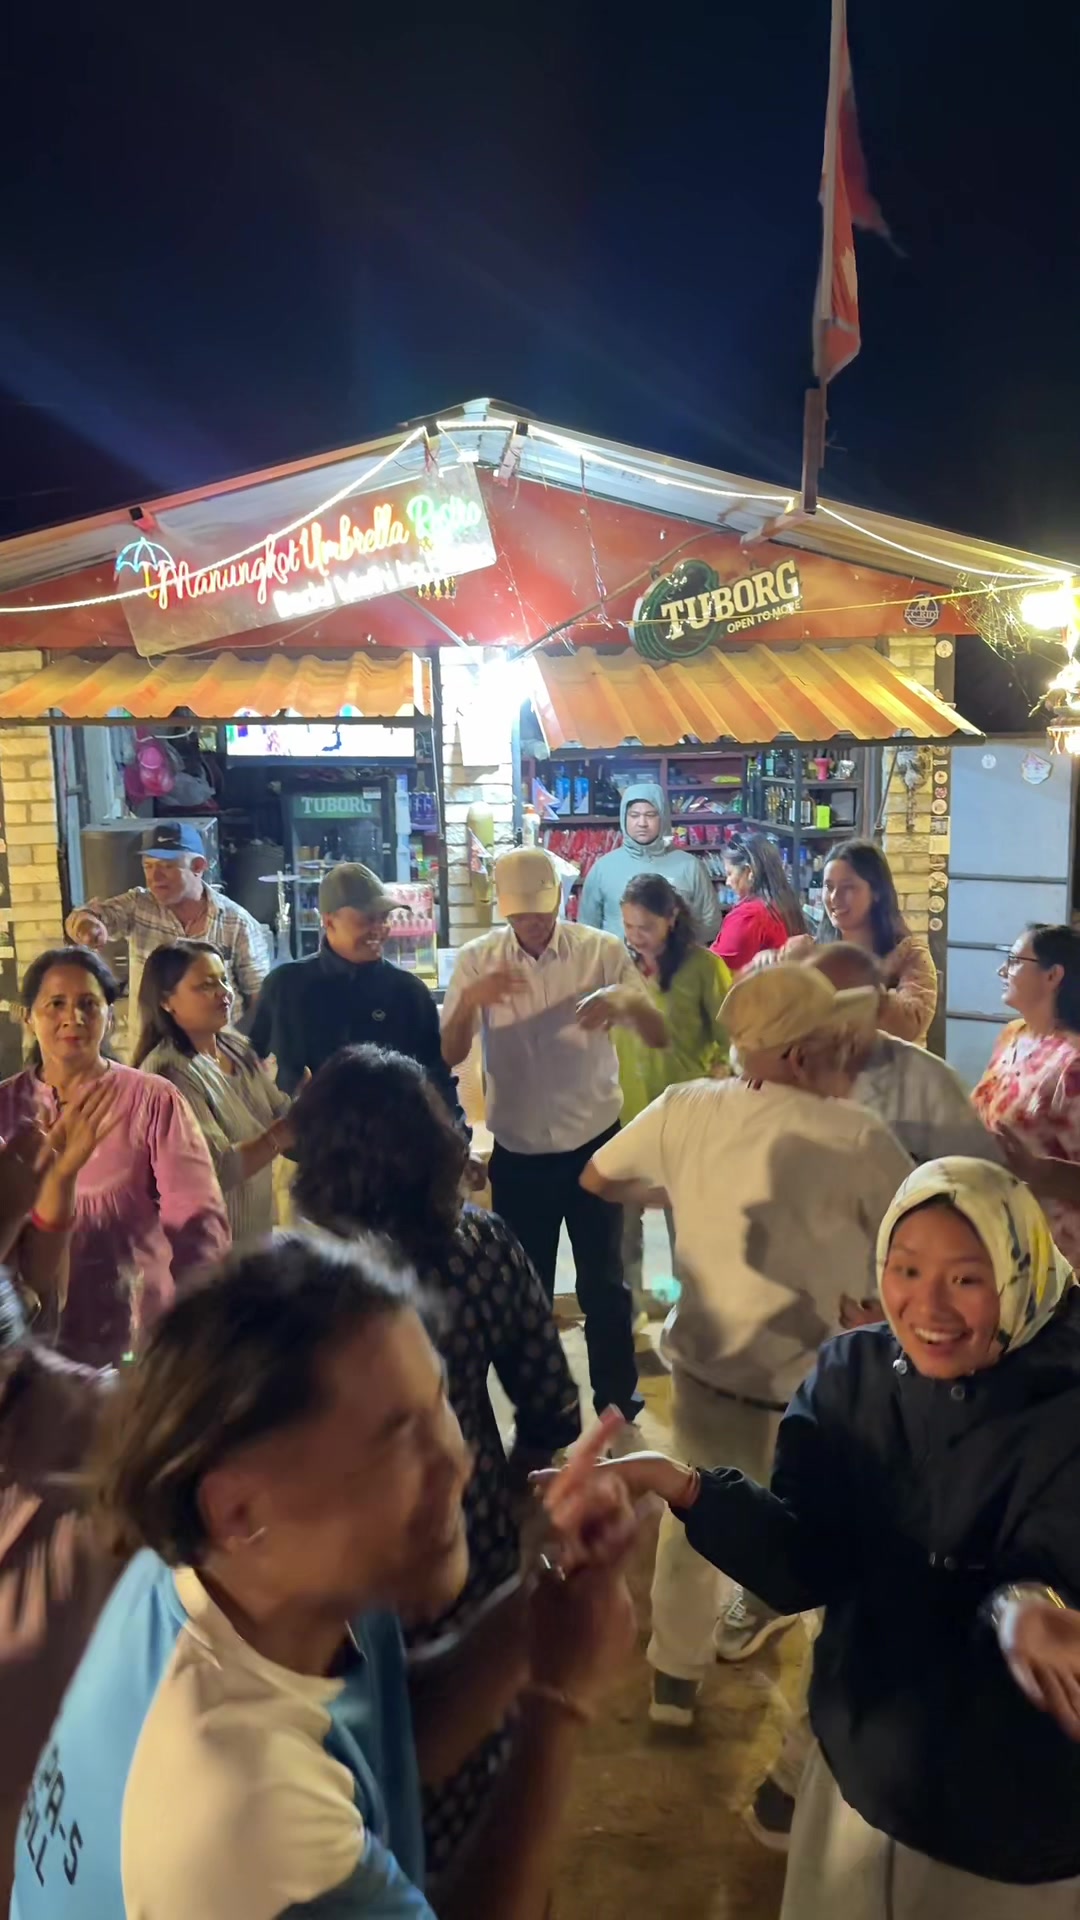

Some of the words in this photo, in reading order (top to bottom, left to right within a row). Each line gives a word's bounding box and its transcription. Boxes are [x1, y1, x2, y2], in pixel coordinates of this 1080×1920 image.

[157, 533, 300, 610] Manungkot
[299, 503, 409, 577] Umbrella
[661, 561, 799, 640] TUBORG
[726, 616, 755, 634] OPEN
[757, 611, 772, 623] TO
[770, 600, 801, 619] MORE
[301, 796, 372, 814] TUBORG
